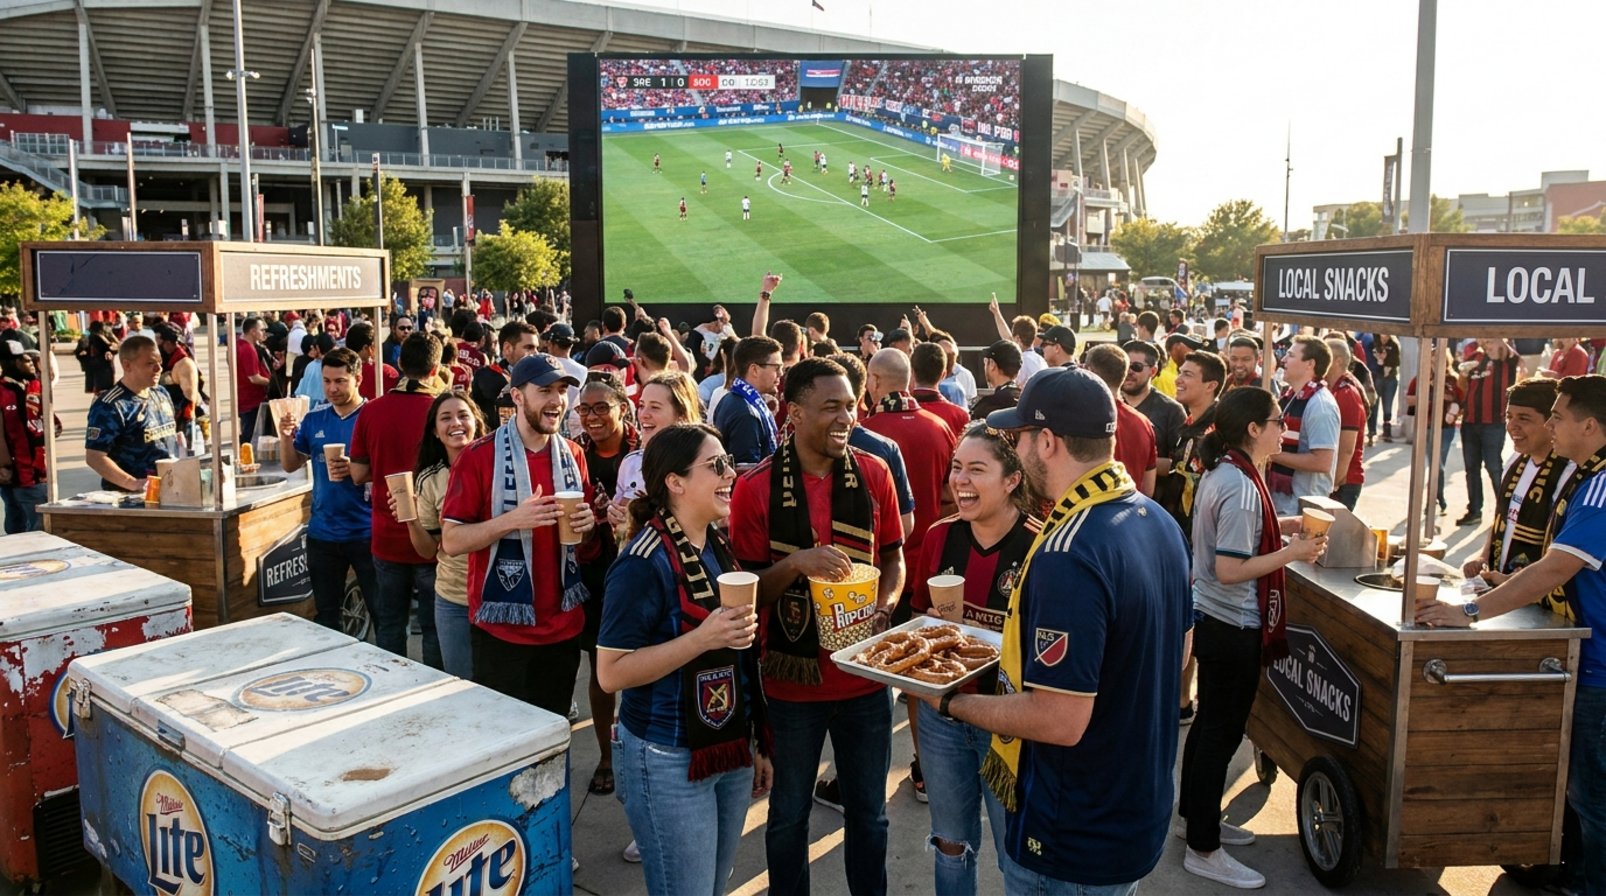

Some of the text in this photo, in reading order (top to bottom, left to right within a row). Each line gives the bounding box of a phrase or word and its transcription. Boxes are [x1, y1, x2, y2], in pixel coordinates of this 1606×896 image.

[250, 264, 361, 290] REFRESHMENTS
[1279, 267, 1389, 302] LOCAL SNACKS
[1486, 266, 1595, 303] LOCAL
[1306, 669, 1351, 722] SNACKS
[147, 813, 205, 896] Lite
[443, 833, 490, 874] Miller
